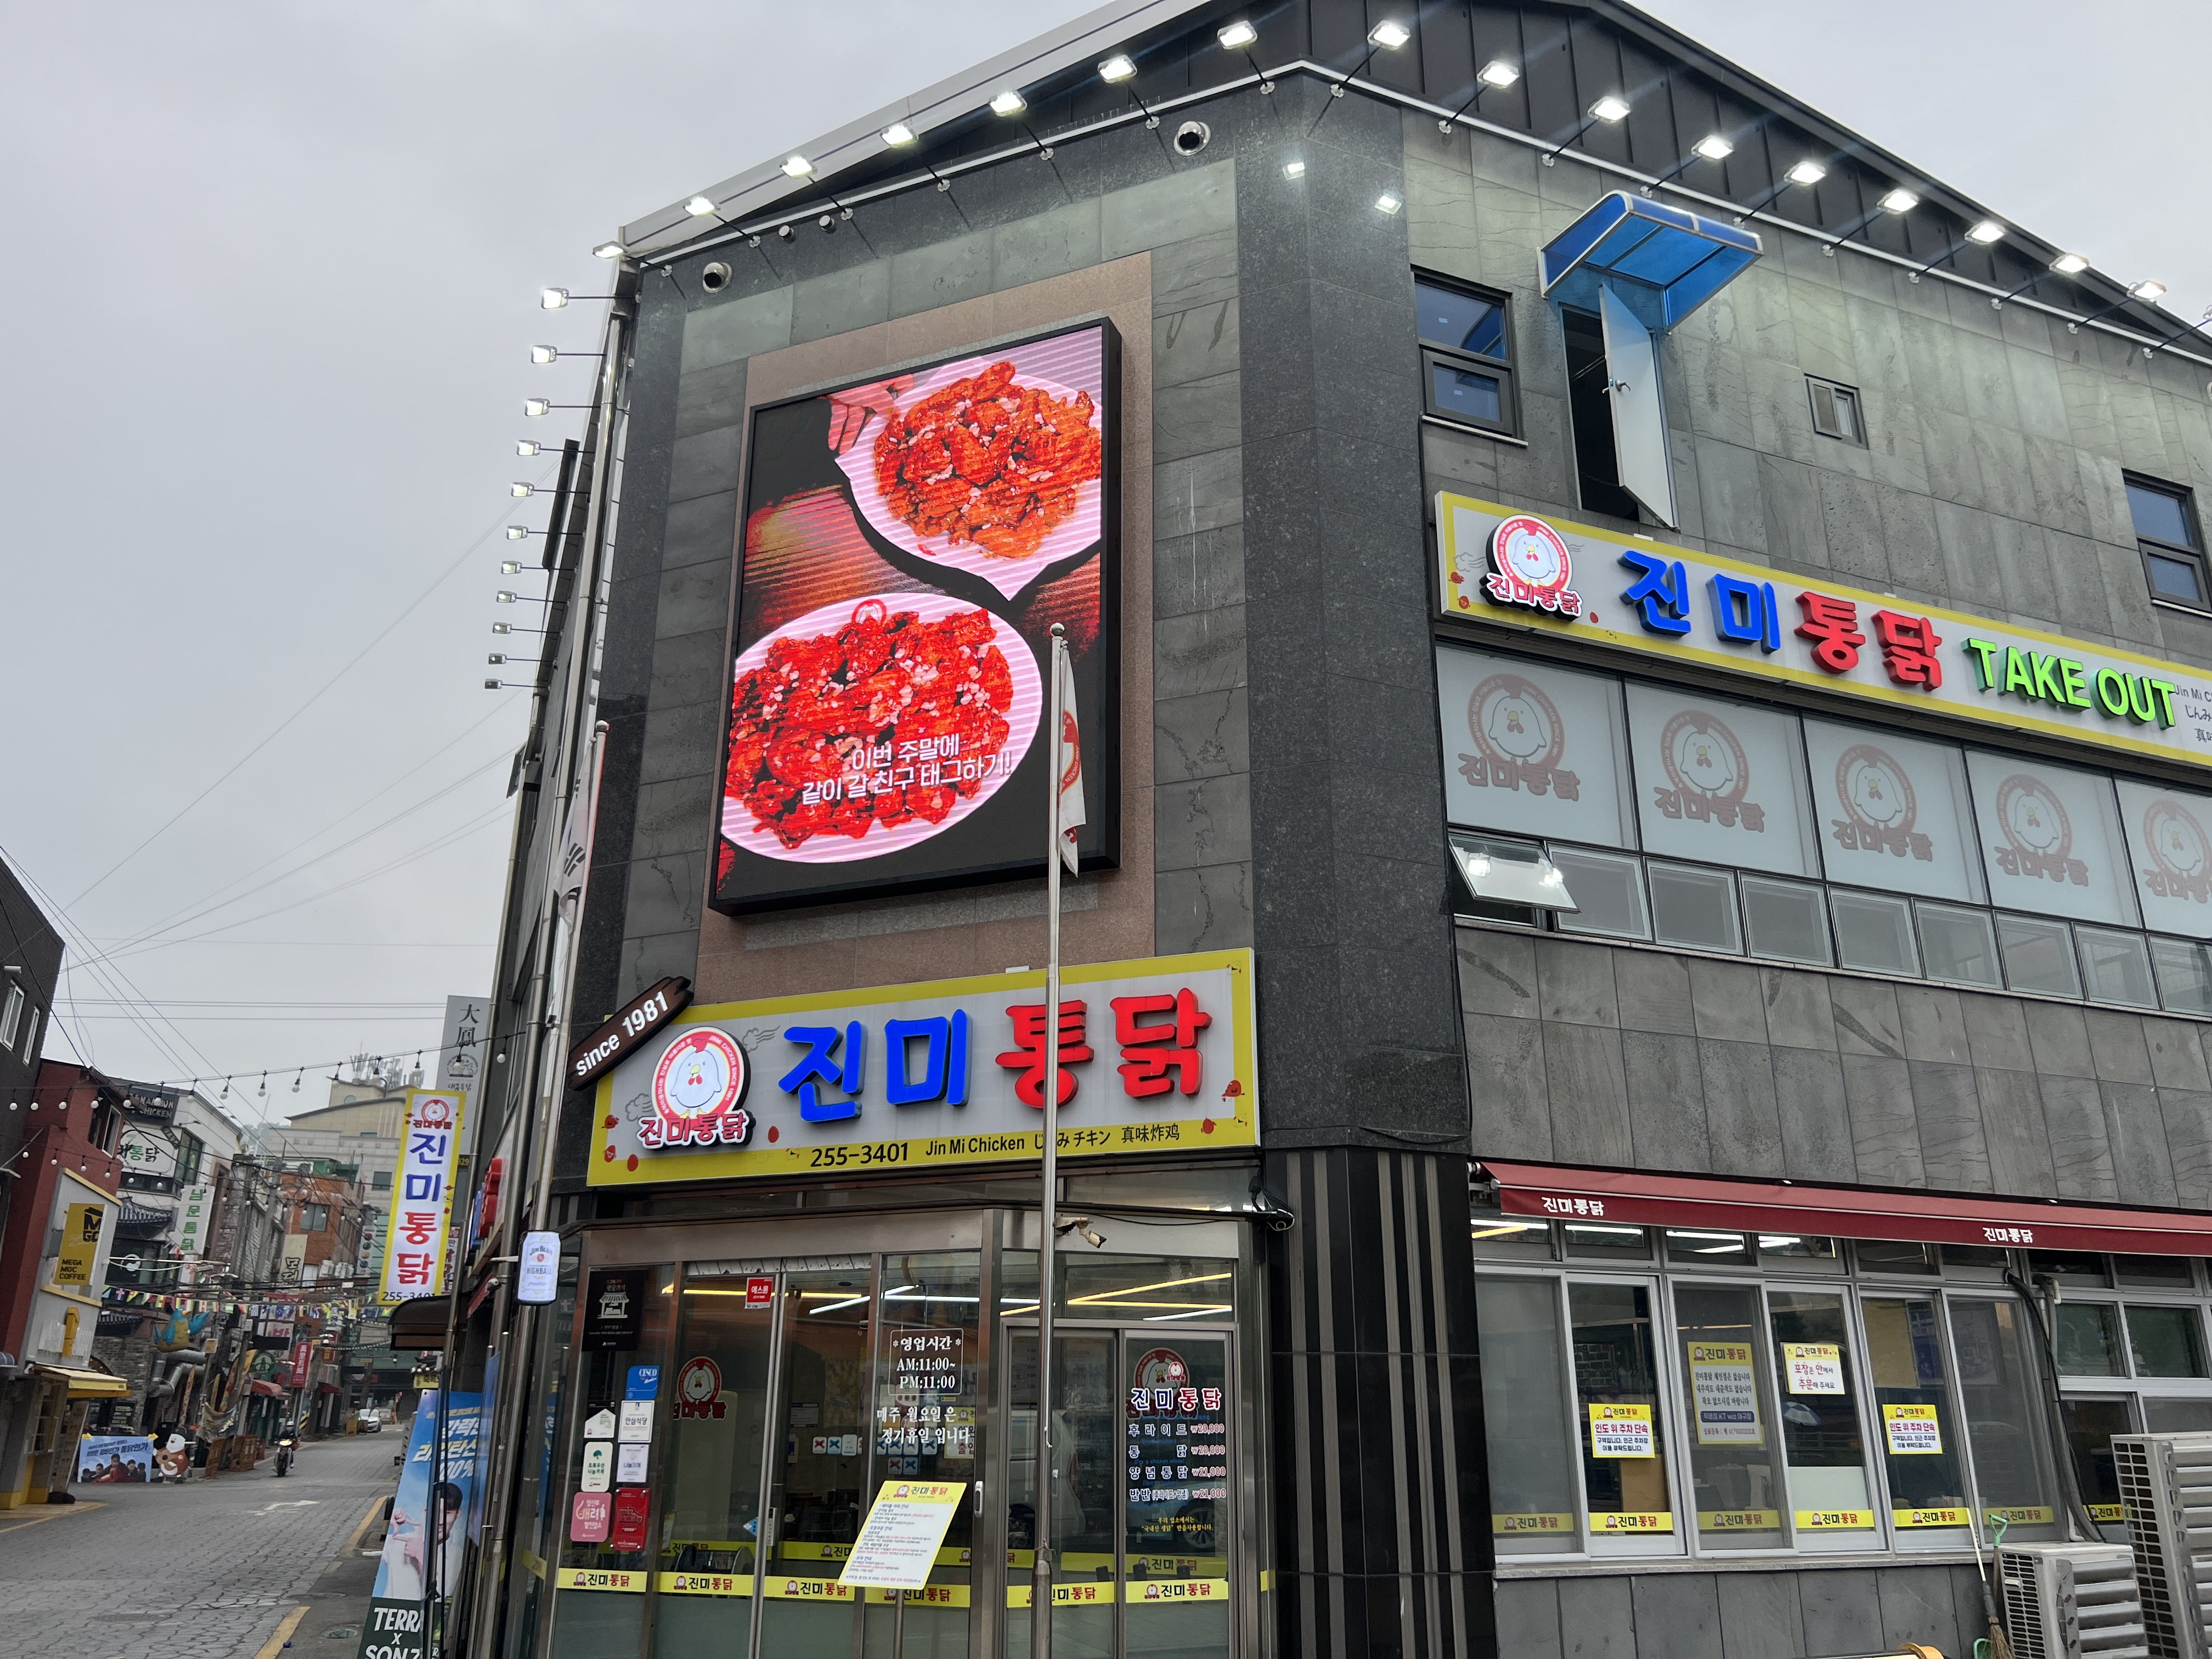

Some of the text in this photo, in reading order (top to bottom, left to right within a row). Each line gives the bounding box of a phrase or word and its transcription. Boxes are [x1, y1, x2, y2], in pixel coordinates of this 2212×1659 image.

[1489, 575, 1580, 614] 진미통닭
[1616, 550, 1942, 692] 진미통닭
[1961, 637, 2176, 730] TAKE OUT
[2176, 685, 2203, 700] Jin Mi
[1538, 695, 1556, 721] CHICKEN
[851, 733, 960, 772] 이번 주말에
[802, 751, 1011, 805] 같이 갈 친구 태그하기!
[1458, 753, 1580, 802] 진미통닭
[1654, 786, 1765, 833] 진미통닭
[2143, 868, 2212, 904] 진미통
[576, 991, 669, 1076] since 1981
[721, 1043, 736, 1066] CHICKEN
[778, 988, 1212, 1125] 진미통닭
[639, 1112, 747, 1146] 진미통닭
[1121, 1123, 1180, 1143] 真味炸鸡
[926, 1136, 1025, 1156] Jin Mi Chicken
[1034, 1129, 1111, 1150] じみチキン
[810, 1142, 909, 1168] 255-3401
[397, 1133, 447, 1285] 진미통닭
[1542, 1197, 1604, 1216] 진미통닭
[1982, 1227, 2033, 1243] 진미통닭
[530, 1245, 553, 1256] JIM BEAM
[901, 1336, 952, 1351] 영업시간
[1706, 1348, 1746, 1359] 진미통닭
[899, 1375, 955, 1389] PM:11:00
[1131, 1387, 1222, 1411] 진미통닭
[625, 1417, 647, 1425] 안심식당
[877, 1407, 900, 1423] 매주
[907, 1406, 941, 1423] 월요일
[882, 1427, 929, 1444] 정기휴일
[935, 1427, 970, 1444] 입니다
[1595, 1424, 1648, 1434] 인도 위 주차 단속
[1889, 1423, 1935, 1431] 인도 위 주차 단속
[911, 1486, 948, 1495] 진미통닭
[1517, 1516, 1559, 1529] 진미통닭
[1618, 1516, 1657, 1528] 진미통닭
[1723, 1514, 1763, 1525] 진미통닭
[1822, 1513, 1858, 1525] 진미통닭
[1922, 1510, 1956, 1523] 진미통닭
[2009, 1509, 2041, 1520] 진미통닭
[588, 1573, 630, 1587] 진미통닭
[689, 1577, 733, 1591] 진미통닭
[800, 1582, 847, 1596] 진미통닭
[1161, 1583, 1211, 1597] 진미통닭
[374, 1607, 420, 1633] TERR
